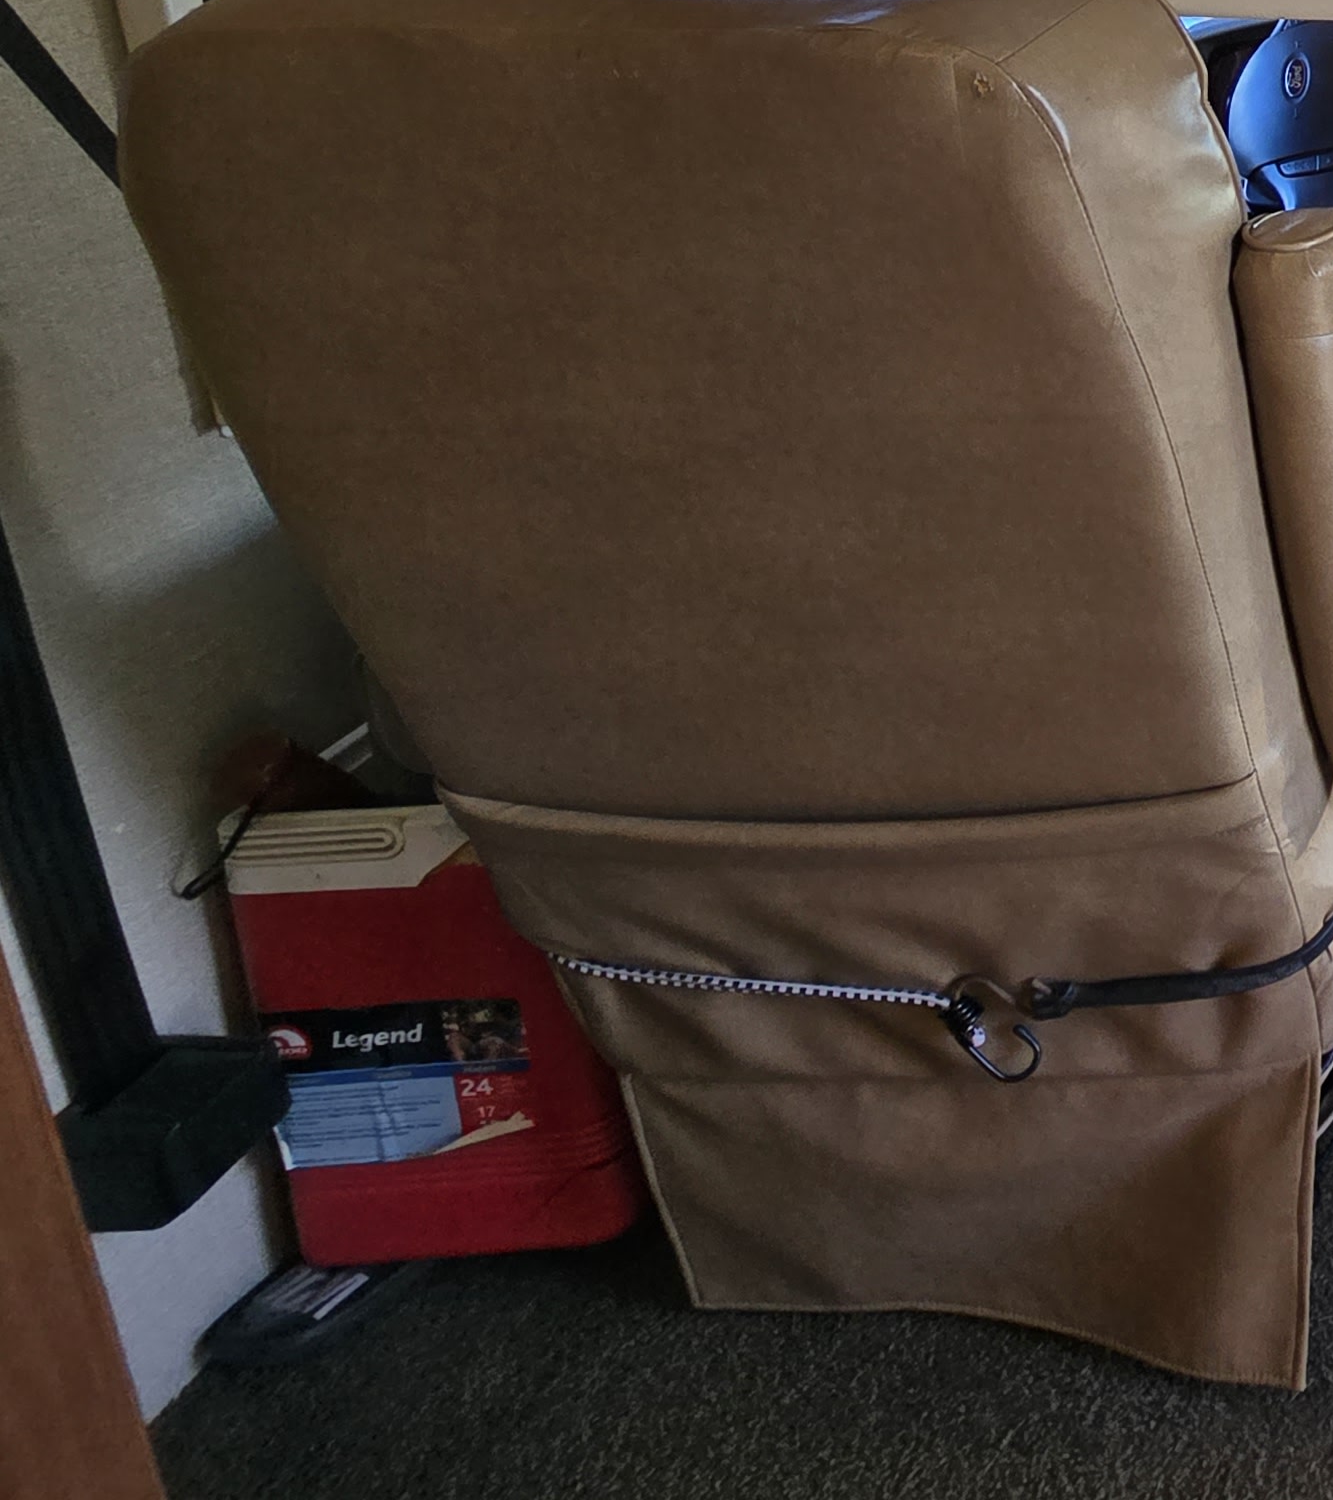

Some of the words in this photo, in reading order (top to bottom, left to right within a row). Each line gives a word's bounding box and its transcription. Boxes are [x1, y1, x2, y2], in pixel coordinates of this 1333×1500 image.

[332, 1023, 424, 1053] Legend
[460, 1078, 494, 1097] 24
[477, 1105, 496, 1119] 17
